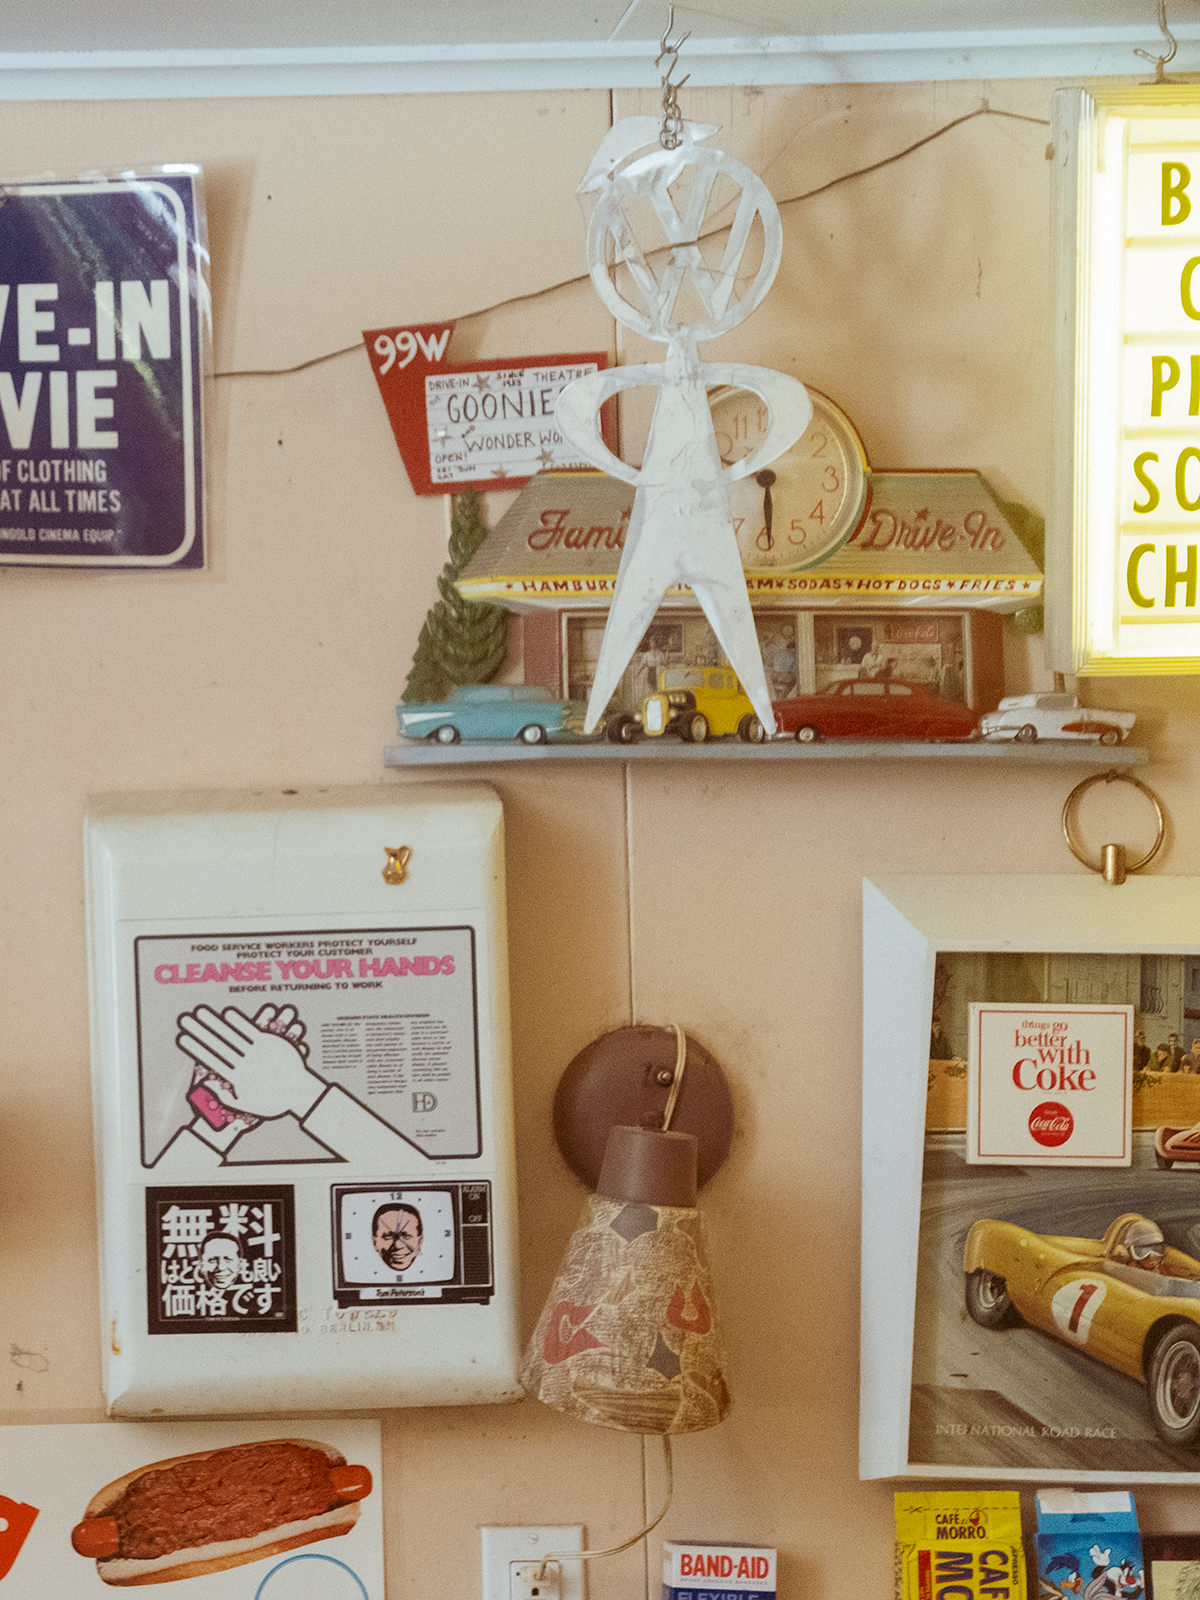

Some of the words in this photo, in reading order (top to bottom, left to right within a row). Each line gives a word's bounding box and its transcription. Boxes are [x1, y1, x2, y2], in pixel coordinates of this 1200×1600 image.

[374, 329, 450, 375] 99W
[429, 377, 470, 391] DRIVE-IN
[447, 388, 566, 424] GOONIE
[464, 432, 536, 451] WONDER
[810, 431, 828, 458] 2
[435, 451, 468, 464] OPEN!
[17, 459, 107, 483] CLOTHING
[822, 466, 840, 492] 3
[0, 489, 22, 511] AT
[29, 490, 61, 512] ALL
[65, 490, 121, 512] TIMES
[809, 499, 825, 525] 4
[39, 529, 80, 542] CINEMA
[527, 509, 632, 551] Fami
[859, 508, 1007, 551] Drive-In
[788, 519, 807, 545] 5
[787, 578, 842, 591] SODAS
[856, 578, 895, 591] HOT
[897, 578, 942, 591] DOGS
[959, 578, 1016, 591] FRIES
[191, 943, 219, 952] FOOD
[222, 942, 262, 951] SERVICE
[266, 941, 315, 950] WORKERS
[318, 939, 364, 948] PROTECT
[368, 937, 418, 946] YOURSELF
[237, 950, 283, 959] PROTECT
[286, 949, 316, 958] YOUR
[318, 947, 373, 957] CUSTOMER
[154, 960, 272, 984] CLEANSE
[275, 957, 355, 981] YOUR
[358, 954, 456, 979] HANDS
[228, 984, 268, 993] BEFORE
[271, 982, 332, 992] RETURNING
[335, 982, 349, 990] TO
[352, 980, 383, 990] WORK
[1014, 1029, 1068, 1048] better
[1052, 1021, 1068, 1034] go
[1038, 1040, 1090, 1065] with
[1012, 1058, 1097, 1091] Coke
[161, 1203, 282, 1259] 無料
[161, 1283, 282, 1317] 価格です
[1067, 1284, 1098, 1333] 1
[935, 1424, 1036, 1437] INTERNATIONAL
[1041, 1426, 1080, 1438] ROAD
[1084, 1427, 1117, 1439] RACE
[935, 1510, 959, 1525] CAFÉ
[936, 1526, 987, 1540] MORRO
[680, 1553, 769, 1579] BAND-AID
